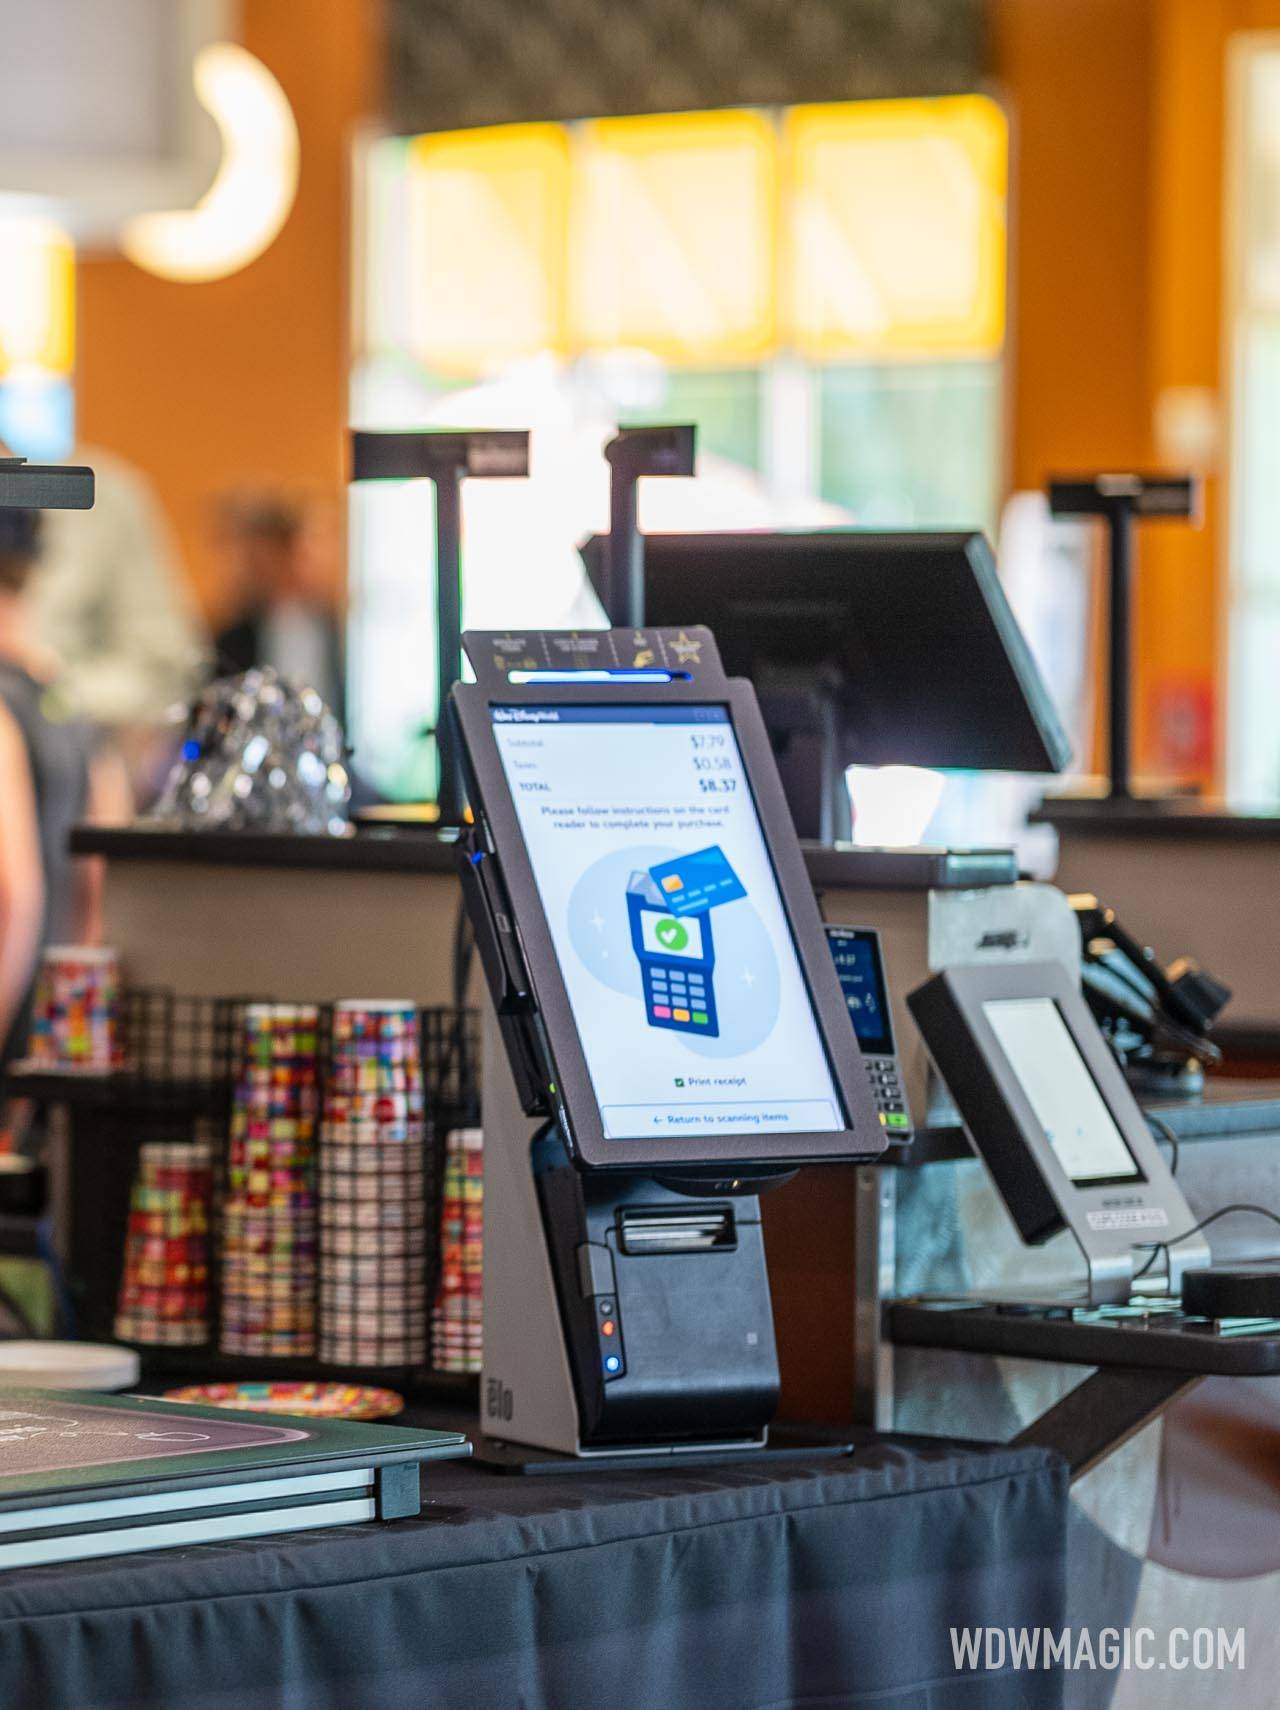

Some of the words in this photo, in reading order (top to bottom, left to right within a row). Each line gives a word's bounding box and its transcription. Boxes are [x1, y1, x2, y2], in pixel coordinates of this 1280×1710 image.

[690, 734, 725, 750] $7.79
[693, 757, 732, 771] $0.58
[519, 782, 551, 793] TOTAL
[699, 778, 737, 793] $8.37
[541, 806, 574, 815] Please
[576, 805, 609, 815] follow
[612, 804, 671, 815] instructions
[688, 805, 705, 814] the
[707, 804, 729, 814] card
[553, 820, 586, 829] reader
[589, 820, 601, 829] to
[603, 819, 649, 832] complete
[652, 821, 674, 831] your
[688, 1076, 711, 1086] Print
[714, 1076, 747, 1087] receipt
[667, 1114, 701, 1124] Return
[703, 1113, 715, 1123] to
[717, 1111, 760, 1125] scanning
[761, 1111, 790, 1121] items
